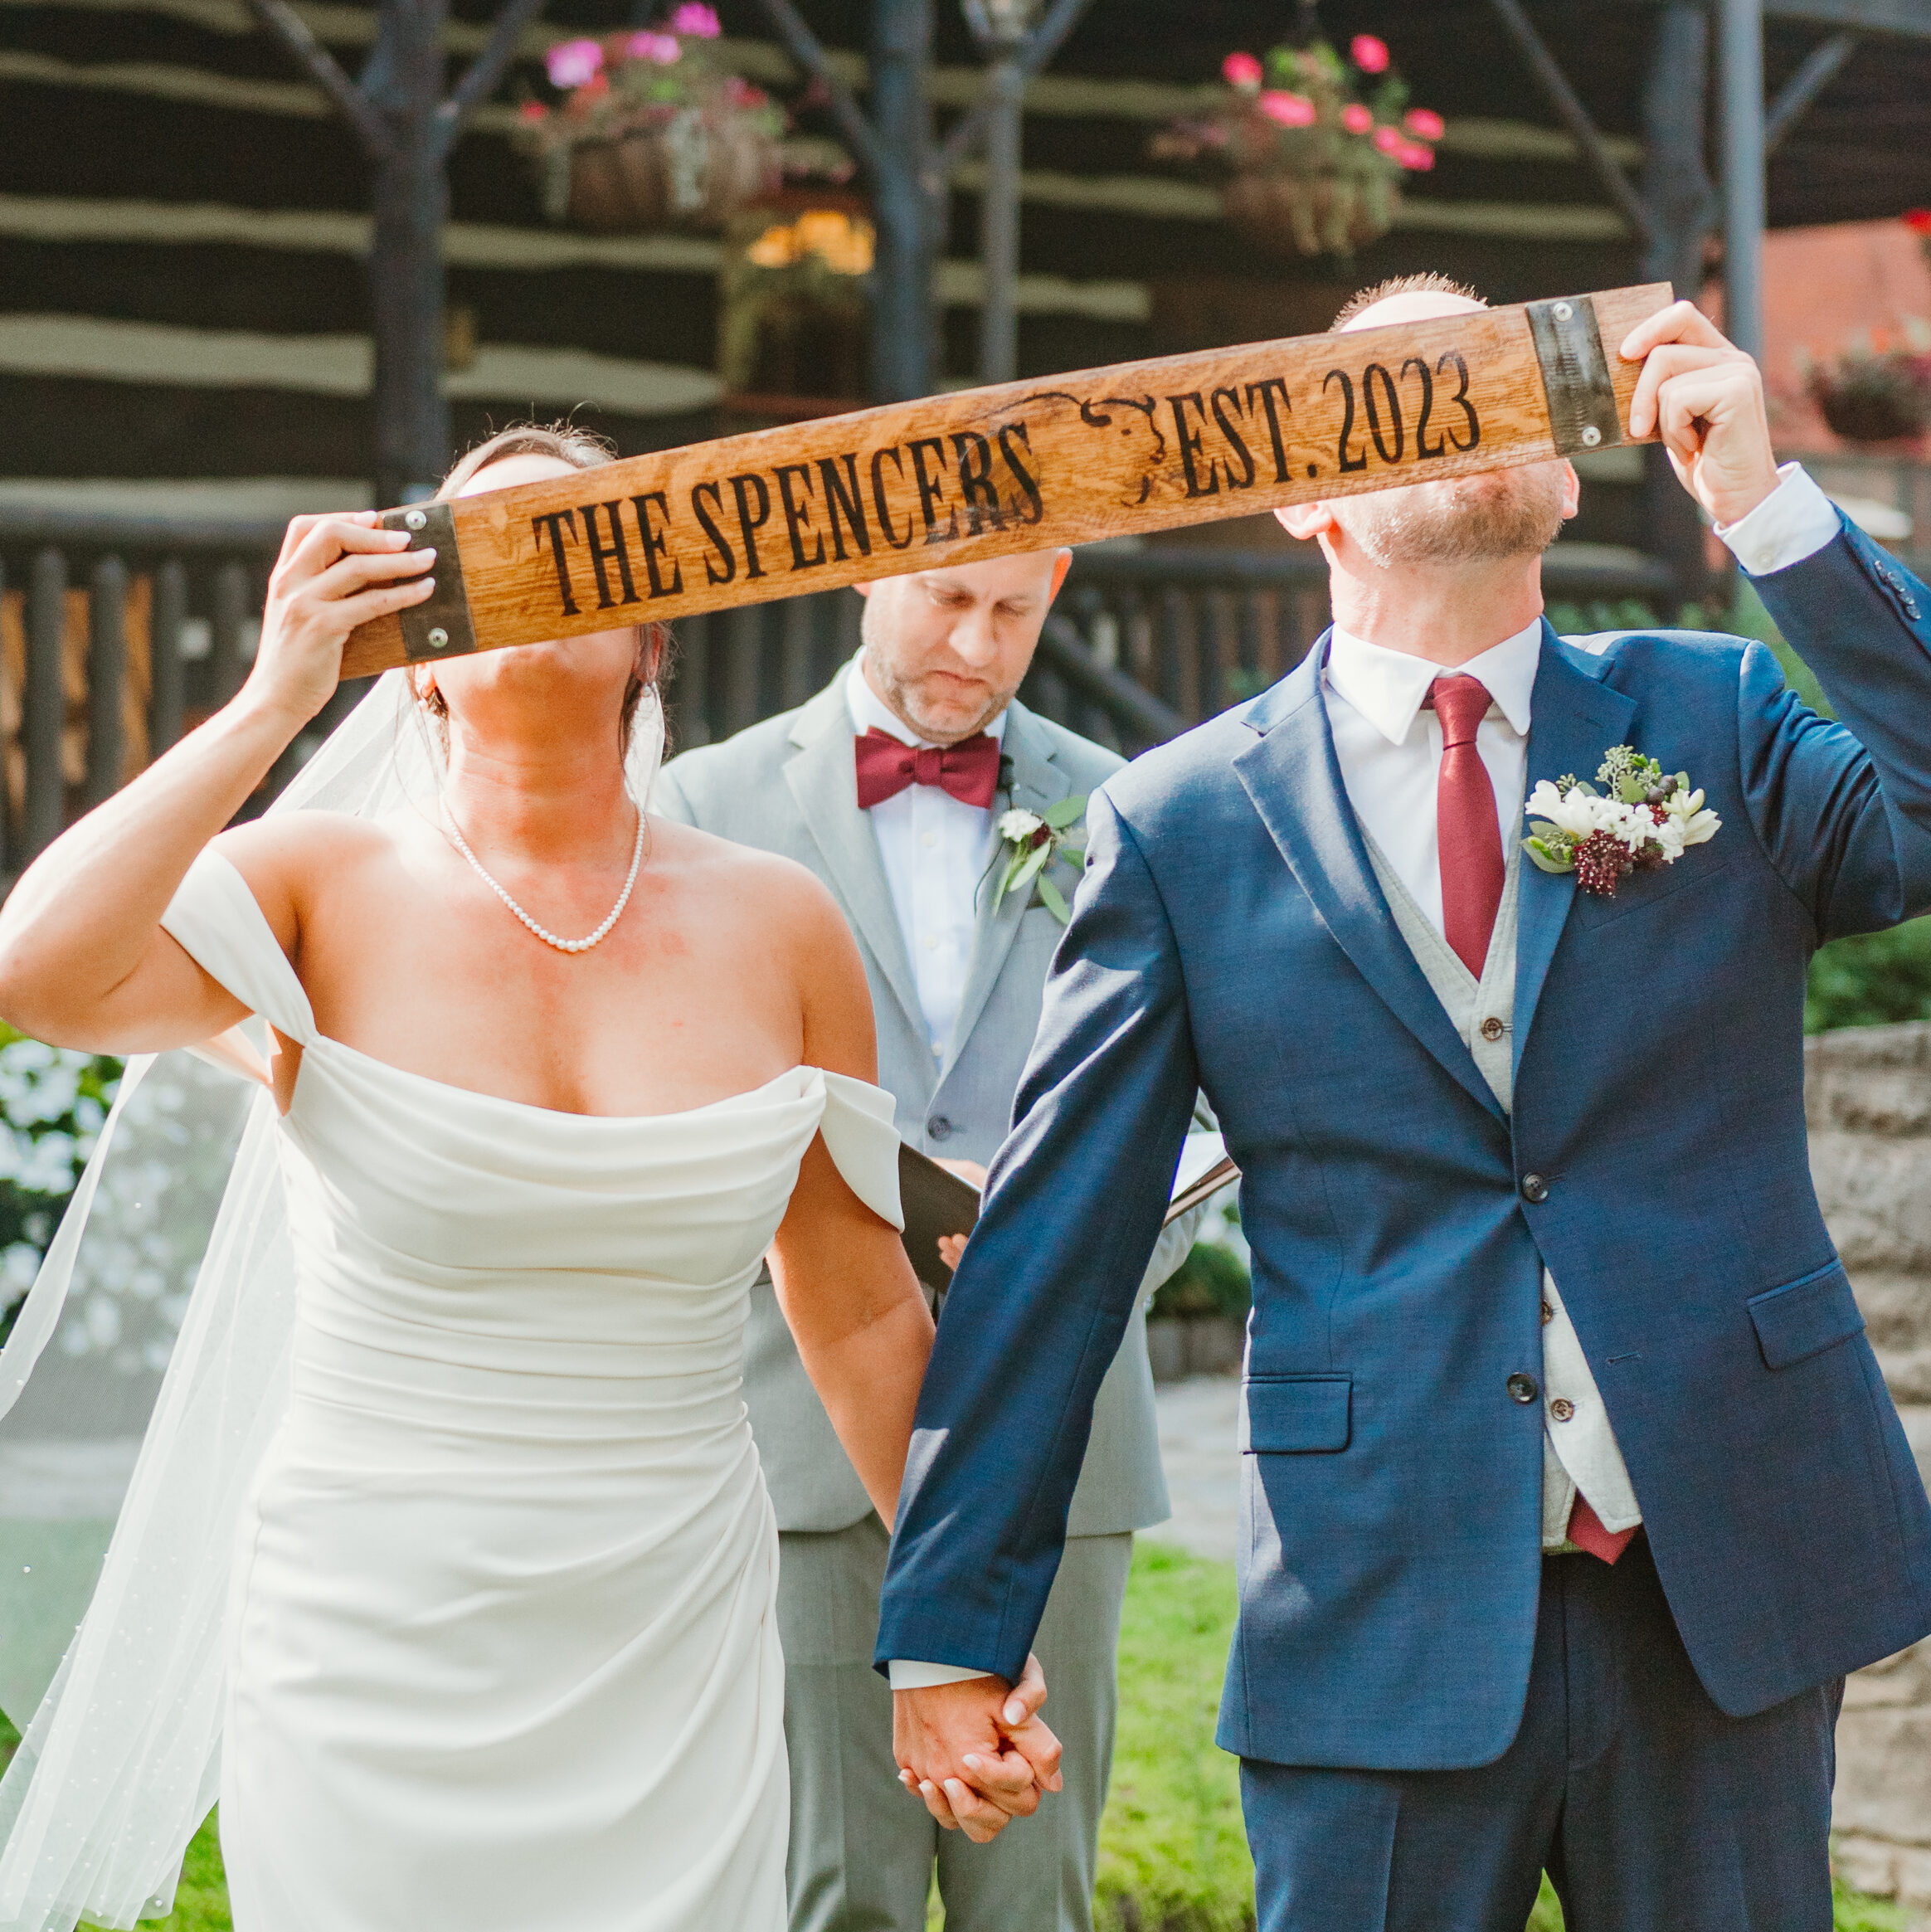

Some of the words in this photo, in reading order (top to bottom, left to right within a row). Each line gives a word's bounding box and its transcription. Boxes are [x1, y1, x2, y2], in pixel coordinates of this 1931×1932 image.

[532, 491, 684, 617] THE
[691, 421, 1043, 586] SPENCERS
[1165, 377, 1317, 498] EST.
[1323, 351, 1481, 474] 2023
